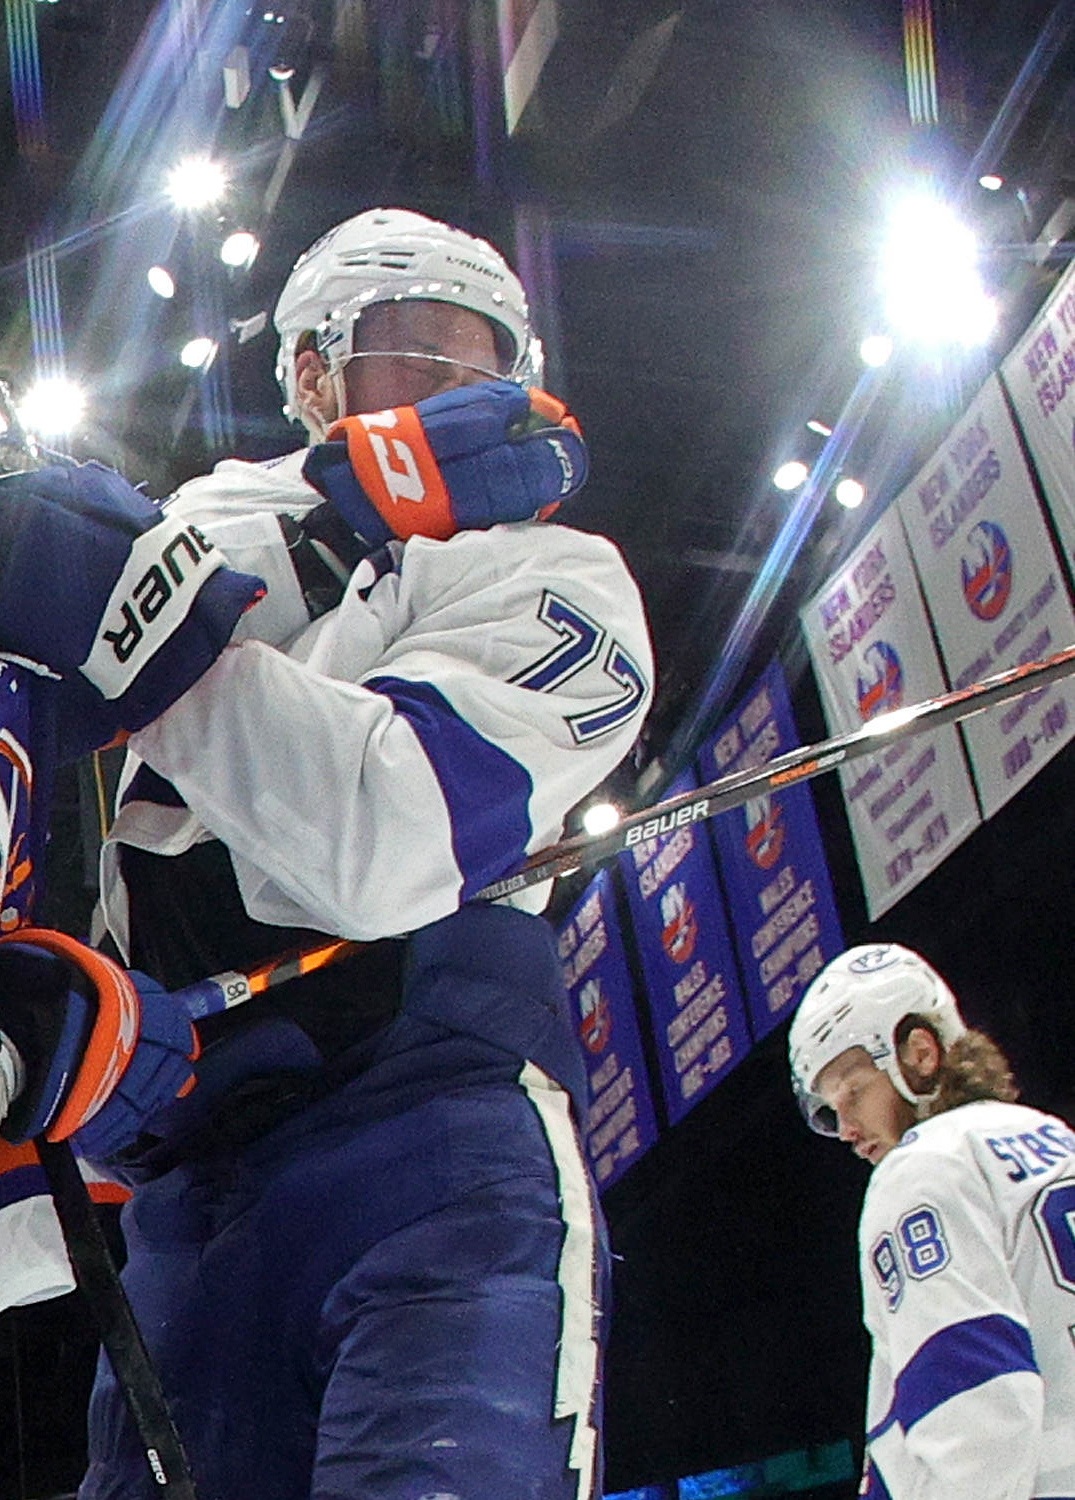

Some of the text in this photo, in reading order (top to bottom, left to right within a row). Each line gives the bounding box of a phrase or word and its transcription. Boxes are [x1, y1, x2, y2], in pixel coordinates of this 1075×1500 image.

[507, 588, 650, 746] 77
[625, 800, 709, 847] BAUER
[868, 1203, 952, 1314] 98
